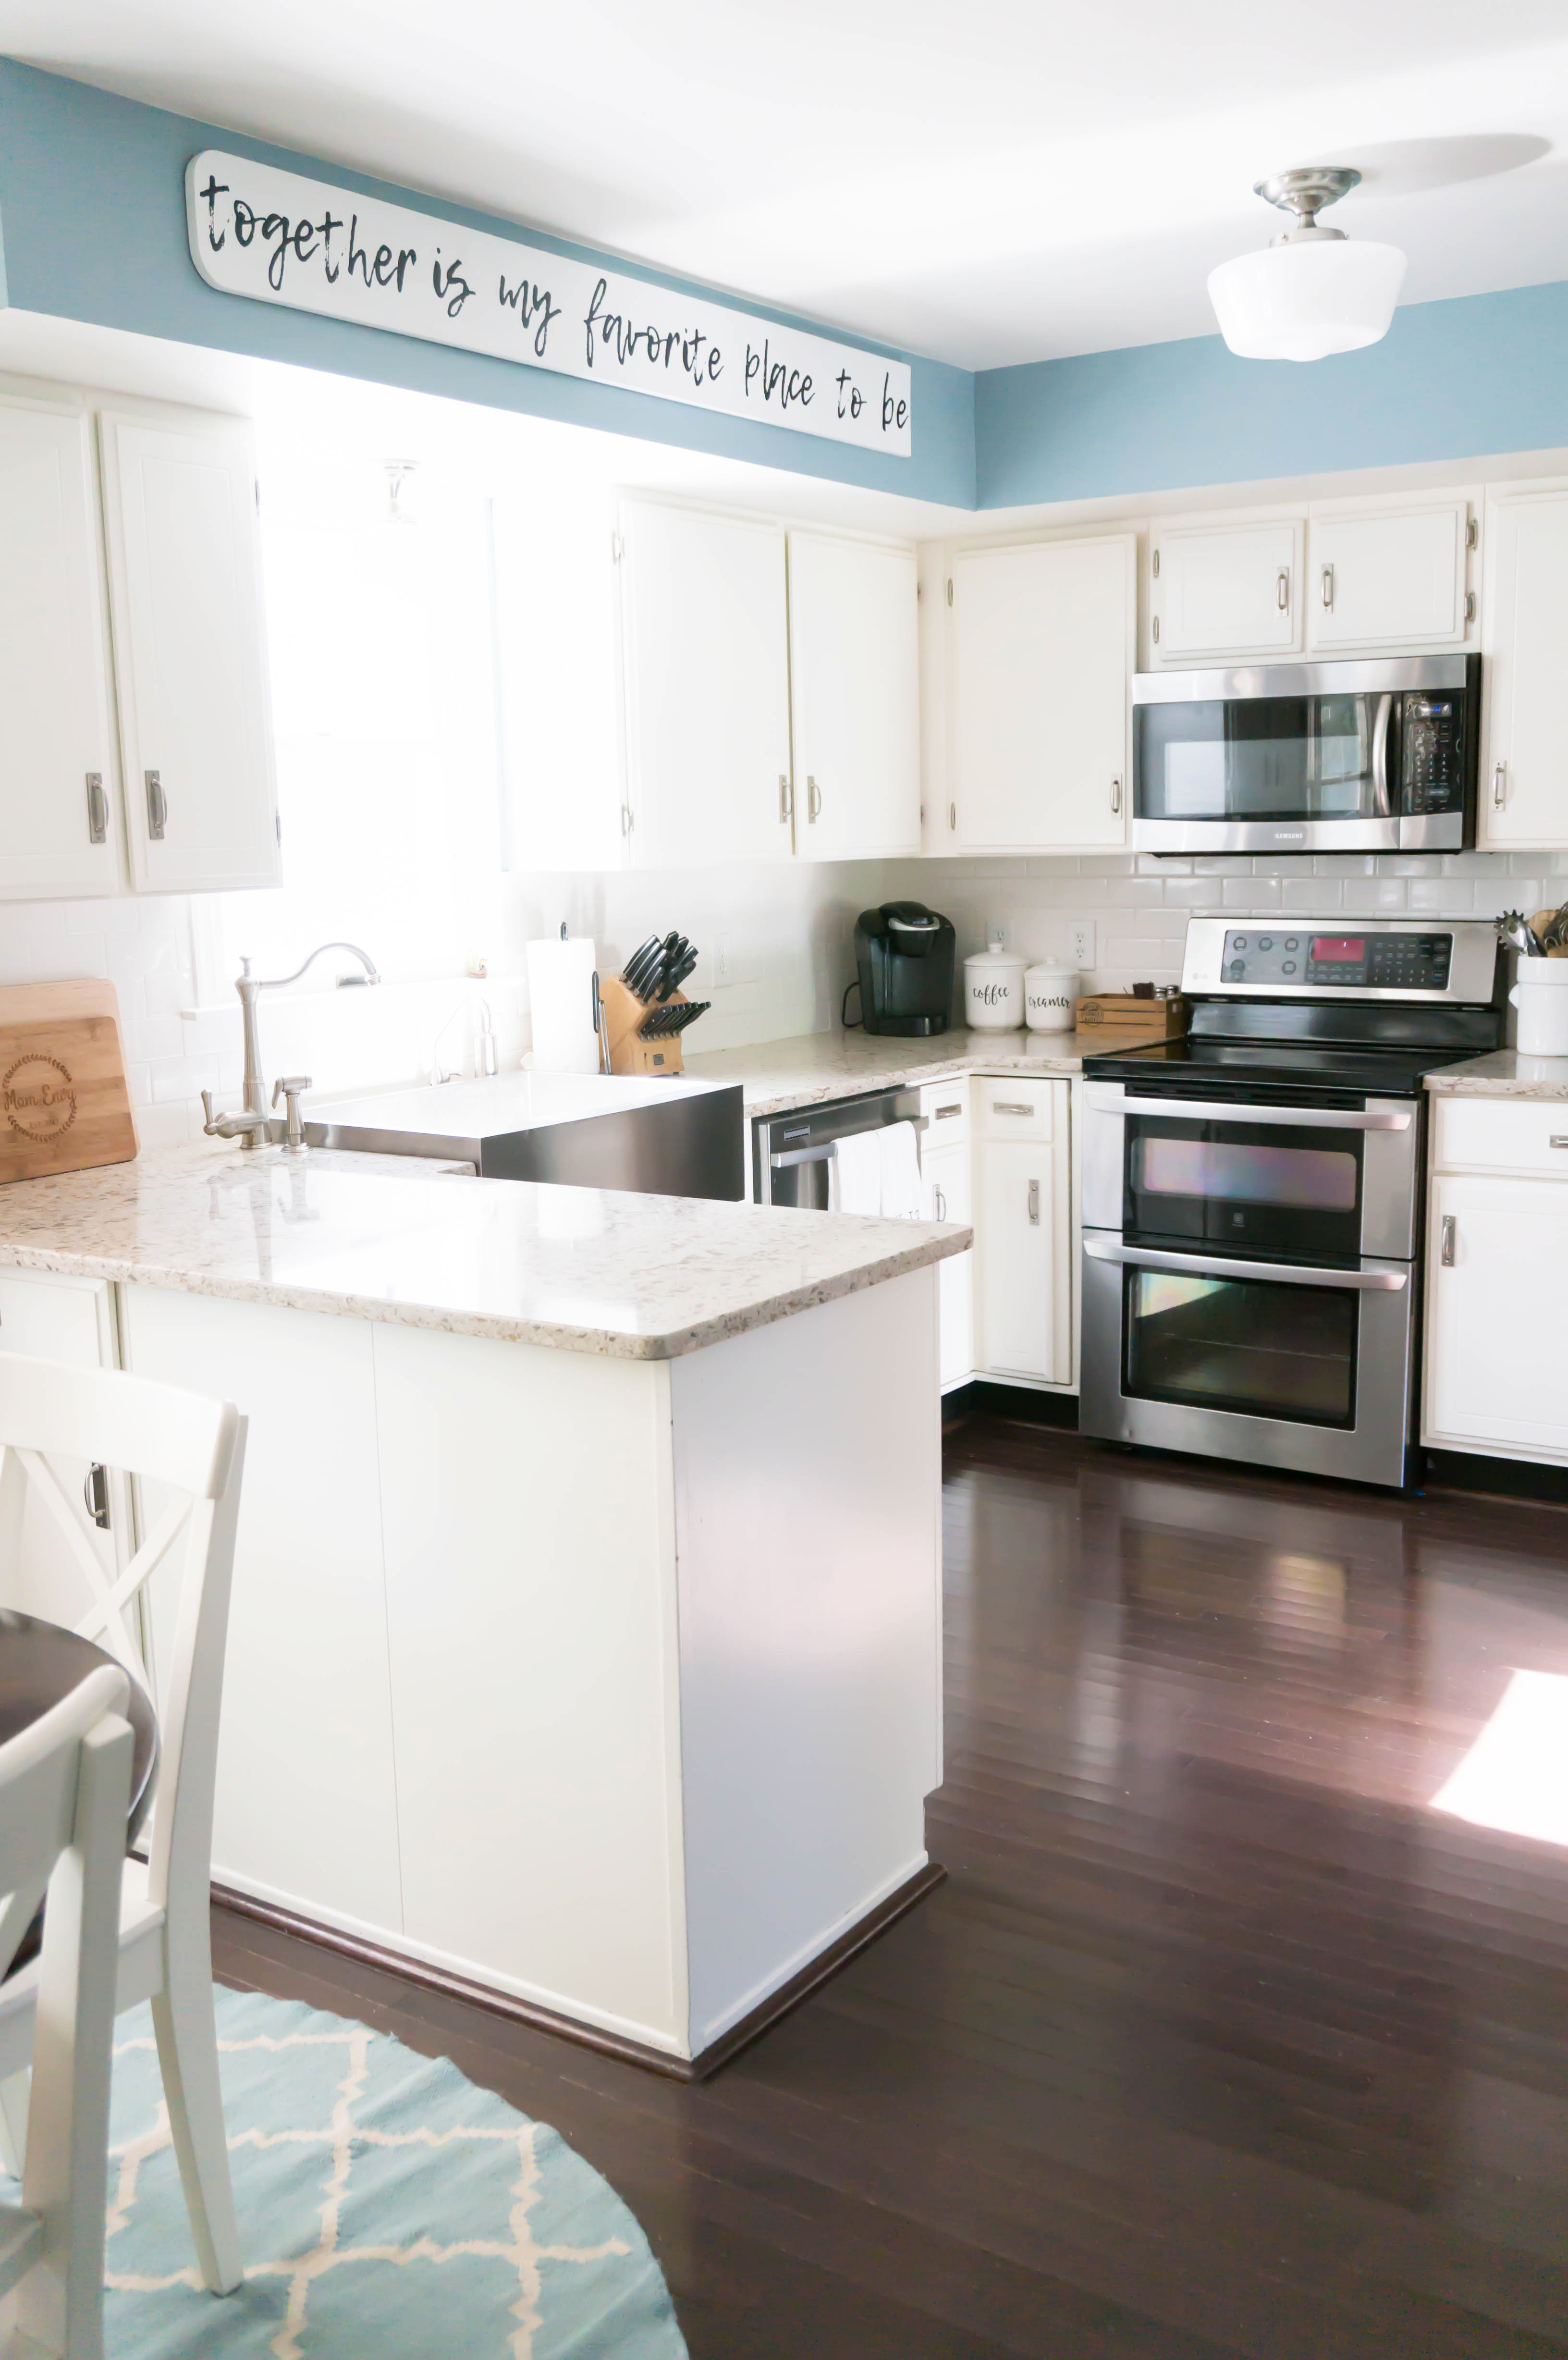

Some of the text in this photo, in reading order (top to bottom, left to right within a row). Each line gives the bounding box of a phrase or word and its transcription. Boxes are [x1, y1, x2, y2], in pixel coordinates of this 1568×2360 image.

[199, 175, 909, 431] together is my favorite place to be
[973, 984, 1009, 1005] coffee
[1029, 996, 1071, 1009] creamer
[4, 1089, 37, 1111] Mom
